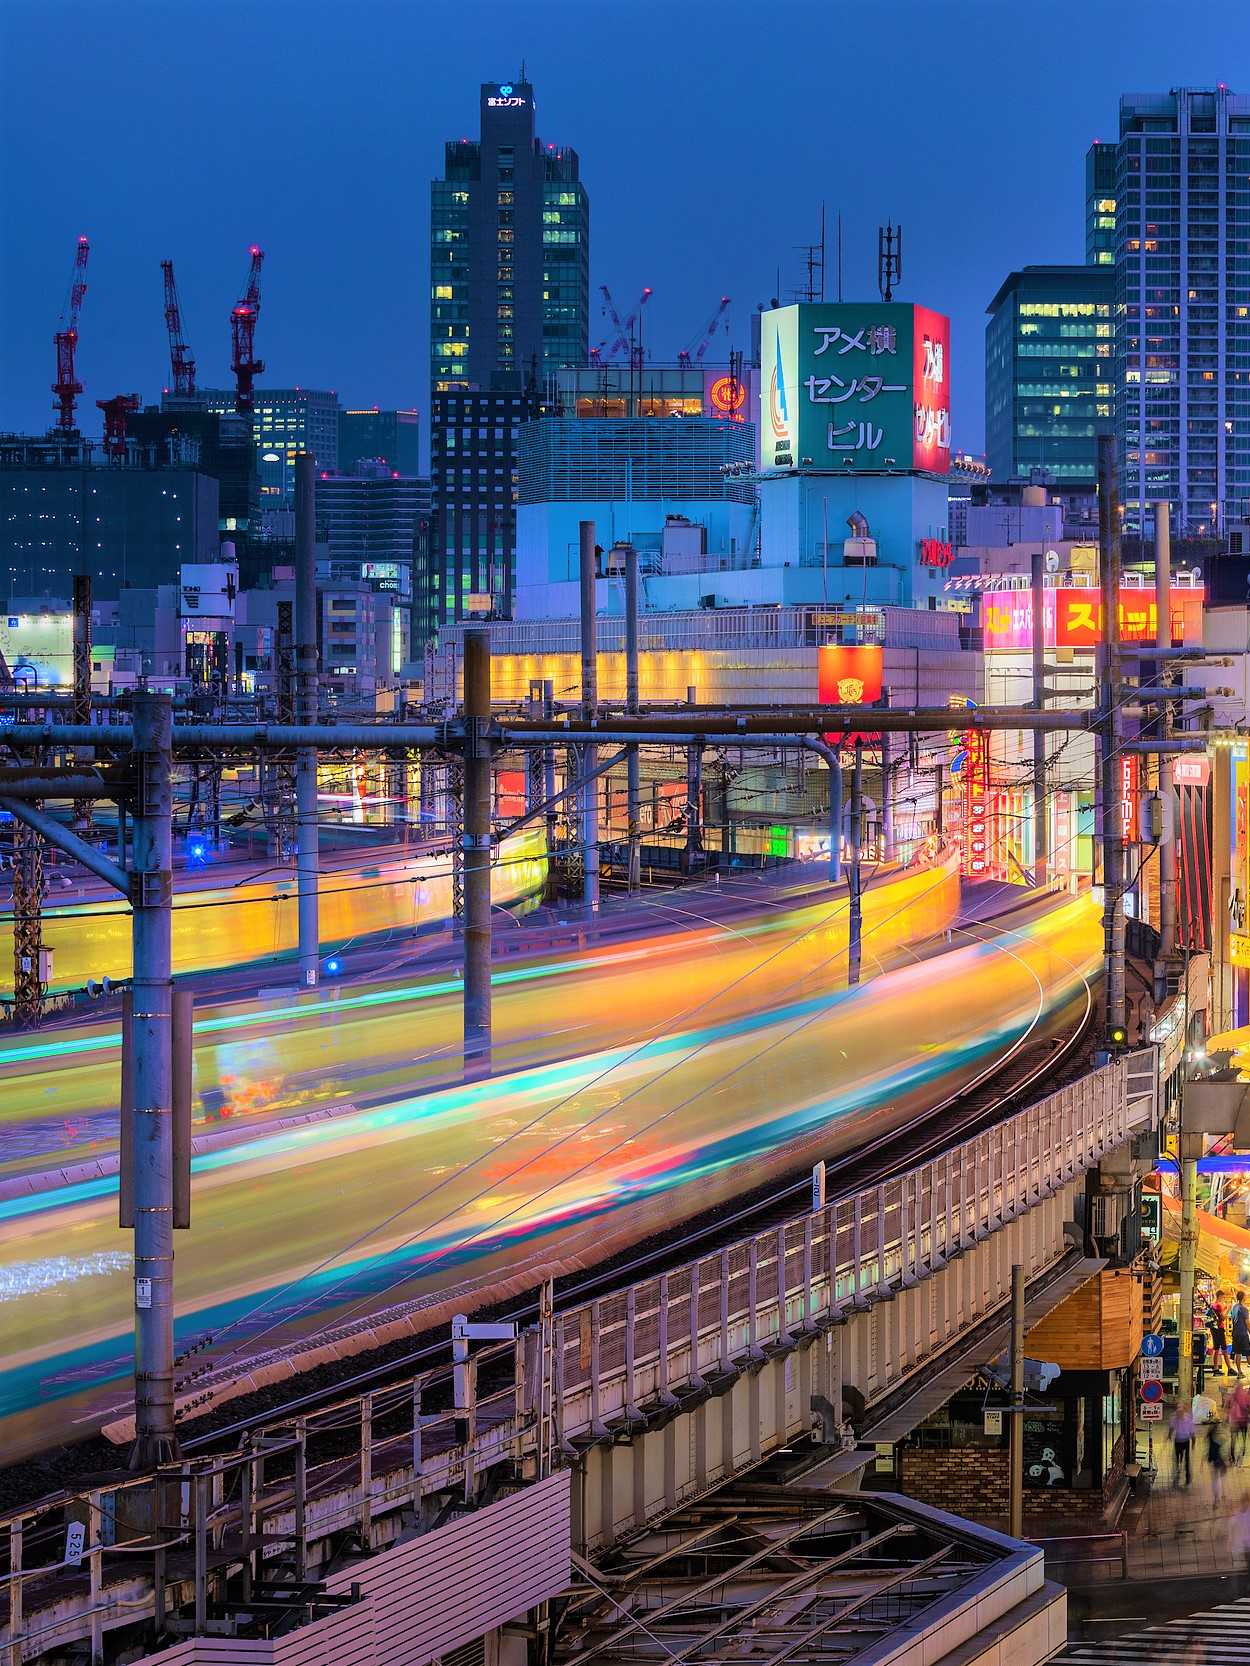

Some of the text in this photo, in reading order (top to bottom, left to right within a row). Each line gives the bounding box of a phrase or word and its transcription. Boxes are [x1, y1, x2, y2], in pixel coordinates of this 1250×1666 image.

[488, 97, 526, 107] 富士ソフト
[813, 324, 897, 355] アメ横
[803, 375, 907, 402] センター
[827, 422, 883, 450] ビル
[68, 1532, 82, 1559] 525
